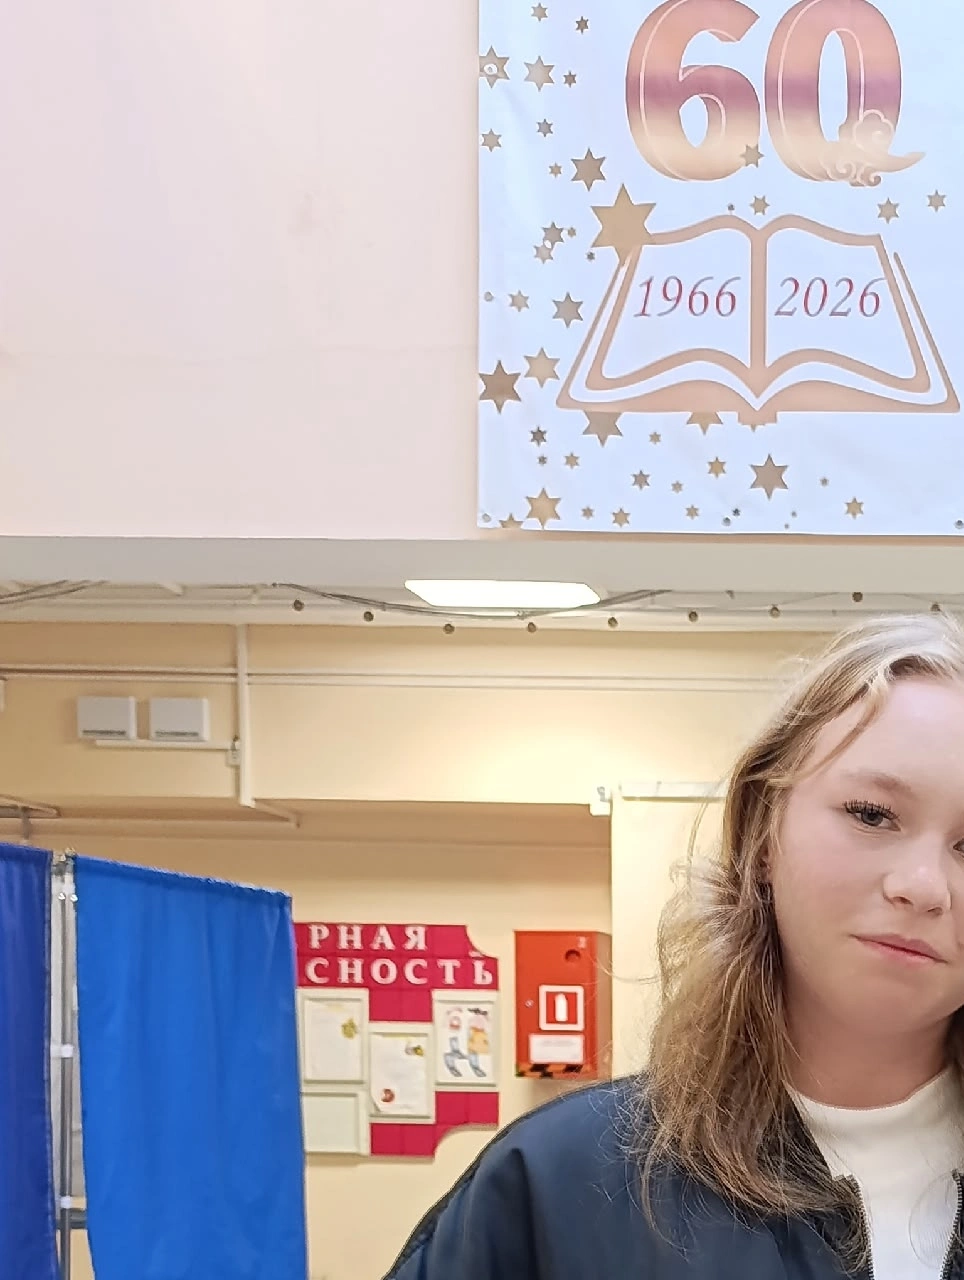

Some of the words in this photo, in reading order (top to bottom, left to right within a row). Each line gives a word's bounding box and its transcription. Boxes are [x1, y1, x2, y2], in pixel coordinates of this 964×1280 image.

[625, 0, 903, 187] 60
[633, 275, 742, 319] 1966
[774, 275, 886, 319] 2026
[308, 924, 428, 951] РНАЯ
[305, 957, 494, 986] СНОСТЬ
